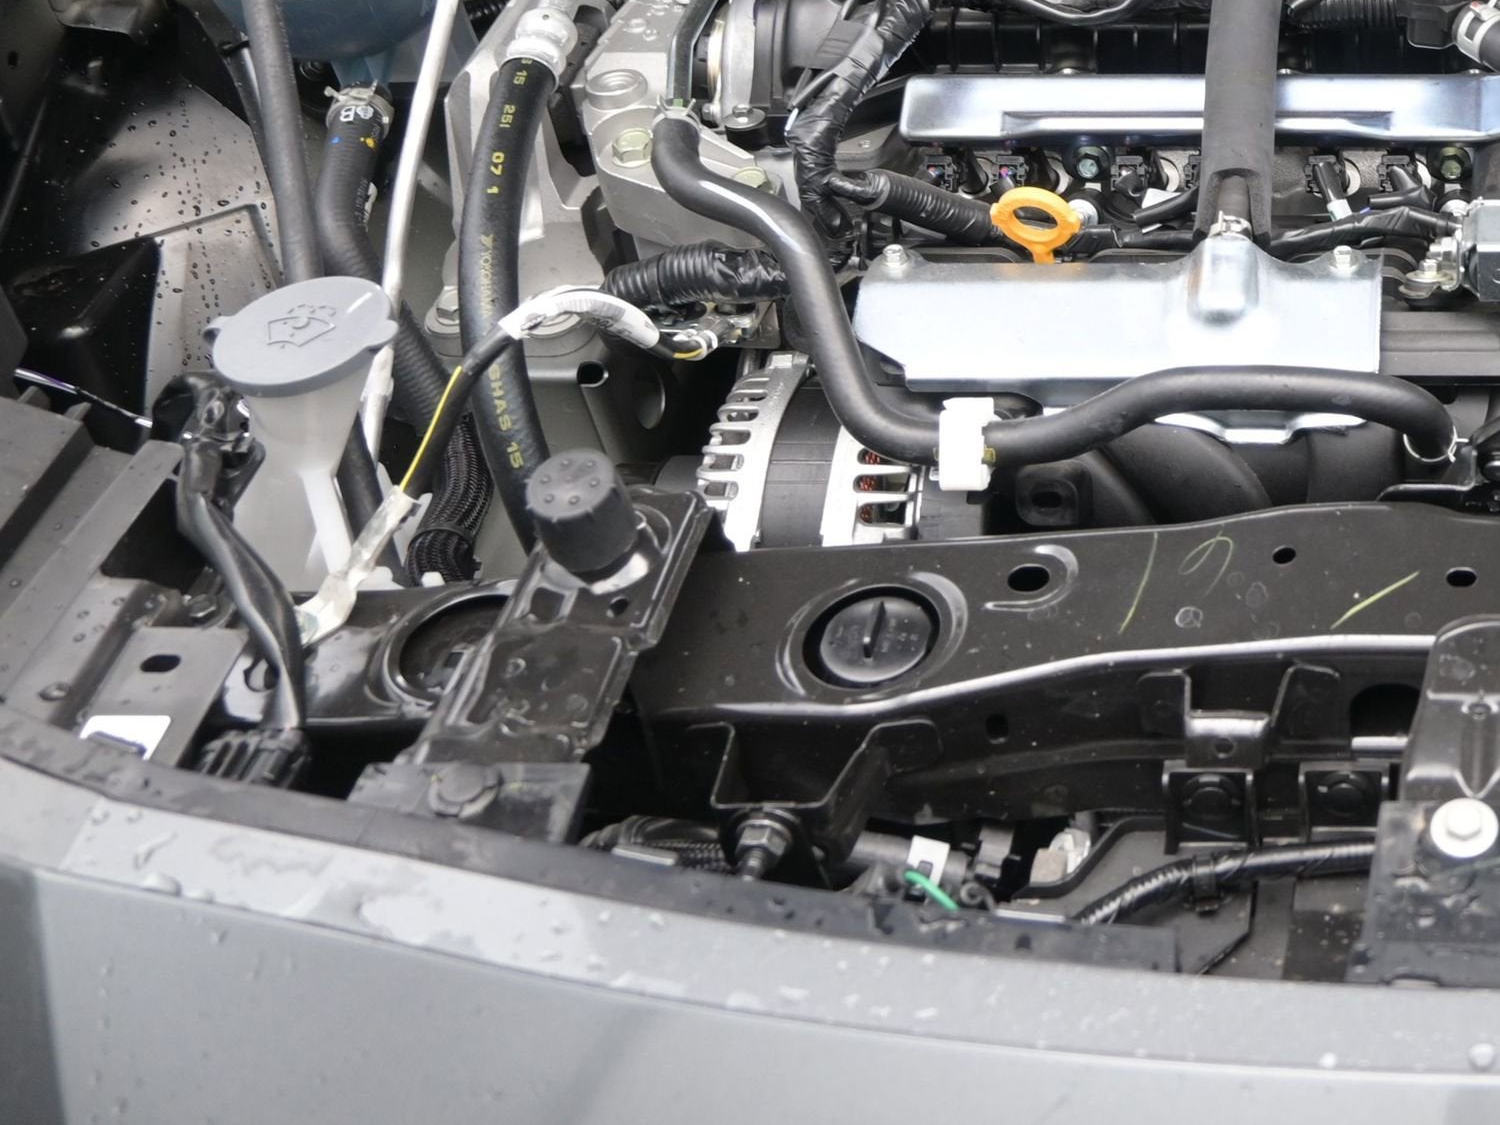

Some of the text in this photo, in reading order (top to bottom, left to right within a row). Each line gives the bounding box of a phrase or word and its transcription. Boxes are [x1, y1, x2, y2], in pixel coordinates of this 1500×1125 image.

[513, 69, 528, 85] 15
[490, 152, 505, 176] 07
[506, 441, 524, 469] 15
